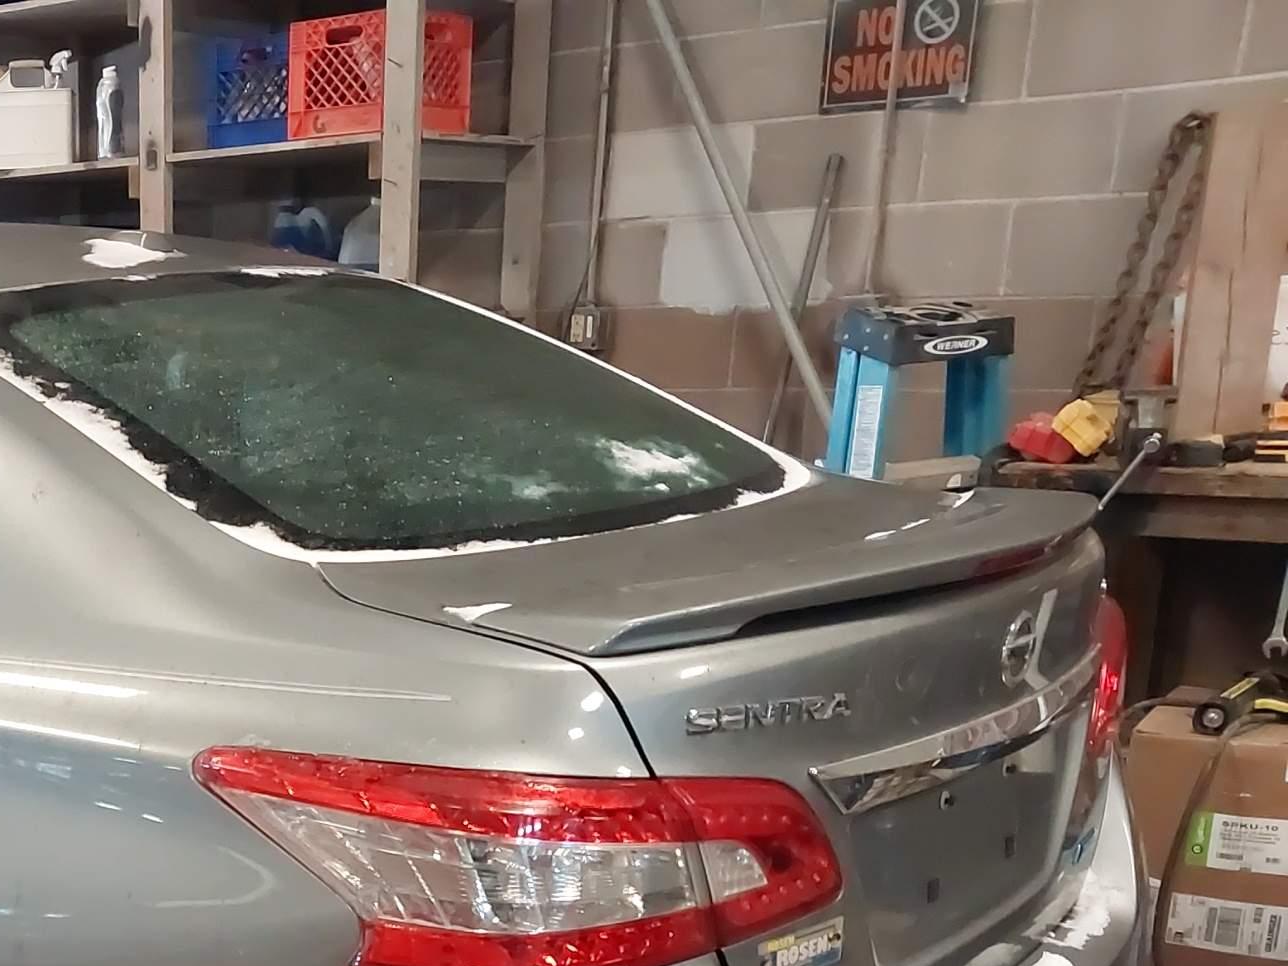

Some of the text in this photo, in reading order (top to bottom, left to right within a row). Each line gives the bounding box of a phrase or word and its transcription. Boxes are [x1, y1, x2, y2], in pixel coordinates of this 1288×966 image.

[856, 6, 897, 47] NO
[831, 44, 966, 94] SMOKING
[936, 338, 977, 351] WERNER
[685, 692, 852, 736] SENTRA
